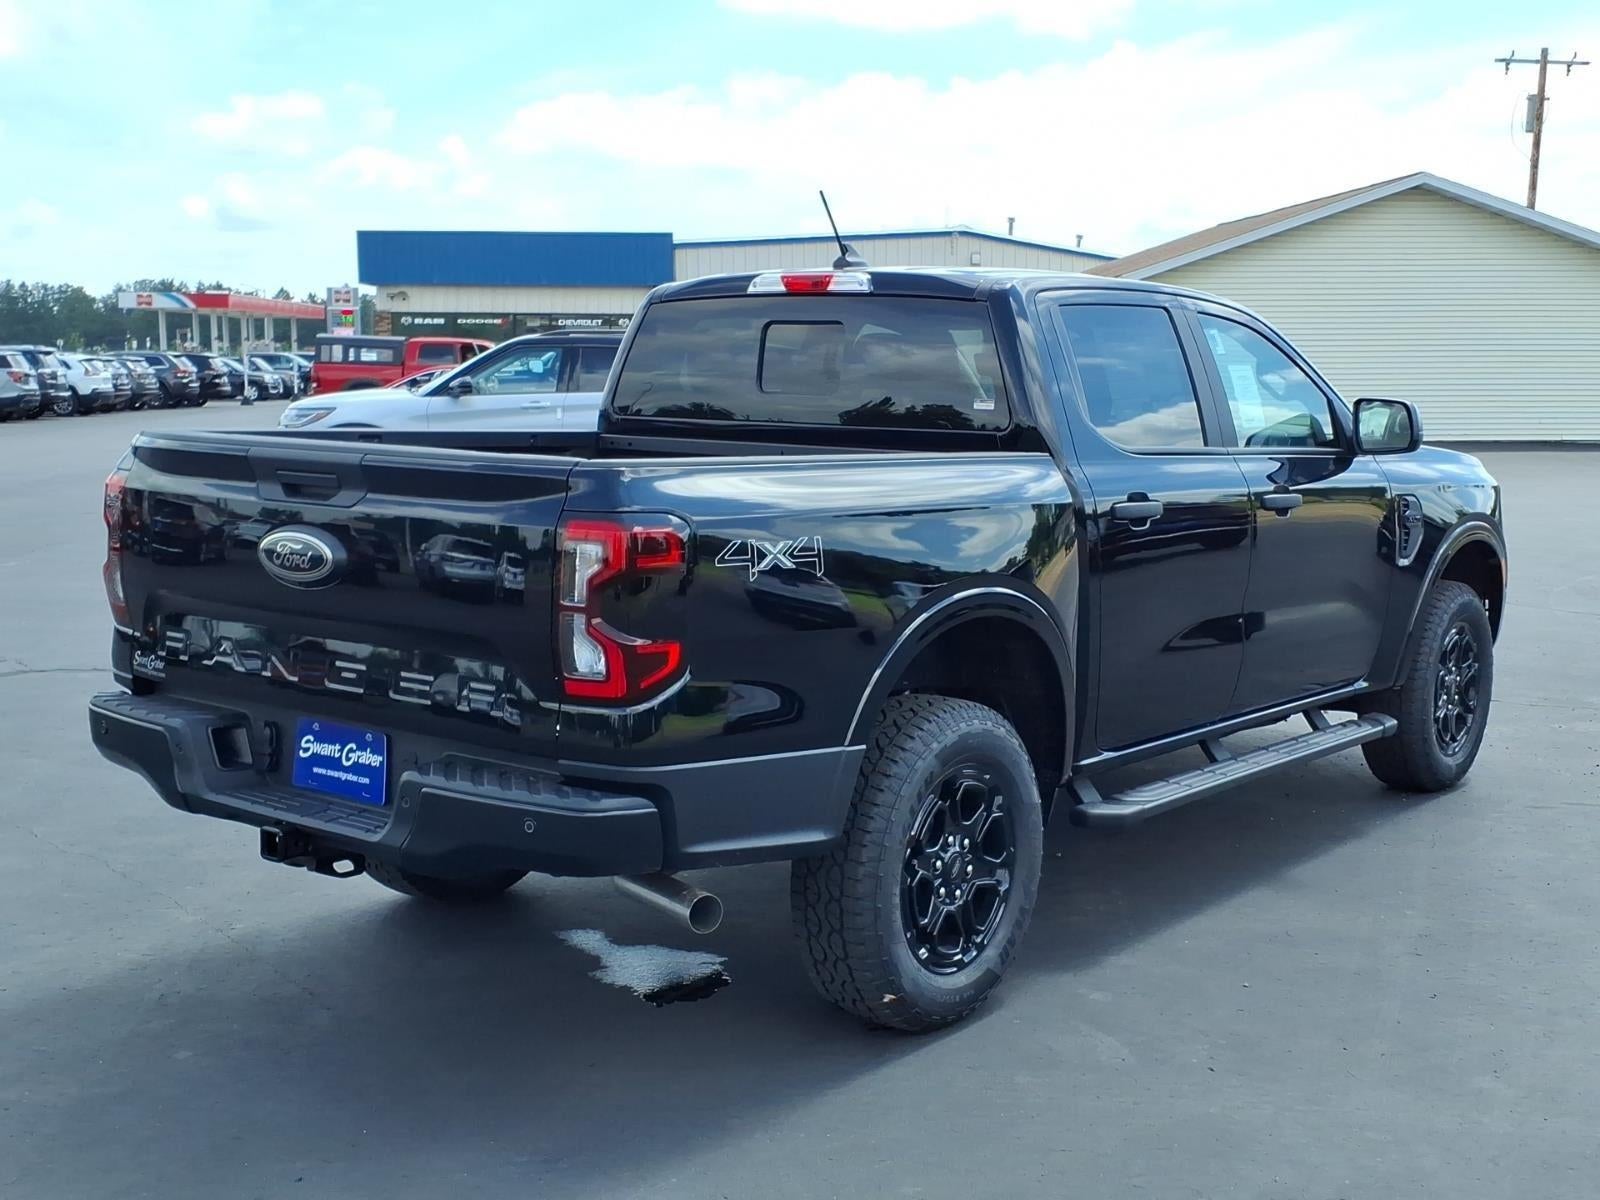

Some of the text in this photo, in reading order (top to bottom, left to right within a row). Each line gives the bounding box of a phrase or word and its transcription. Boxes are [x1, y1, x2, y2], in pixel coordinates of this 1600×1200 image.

[414, 317, 445, 325] RAM
[273, 541, 312, 569] Ford
[157, 630, 504, 717] RANGER
[299, 735, 383, 767] Swant Graber
[312, 767, 370, 785] www.swantgraber.com
